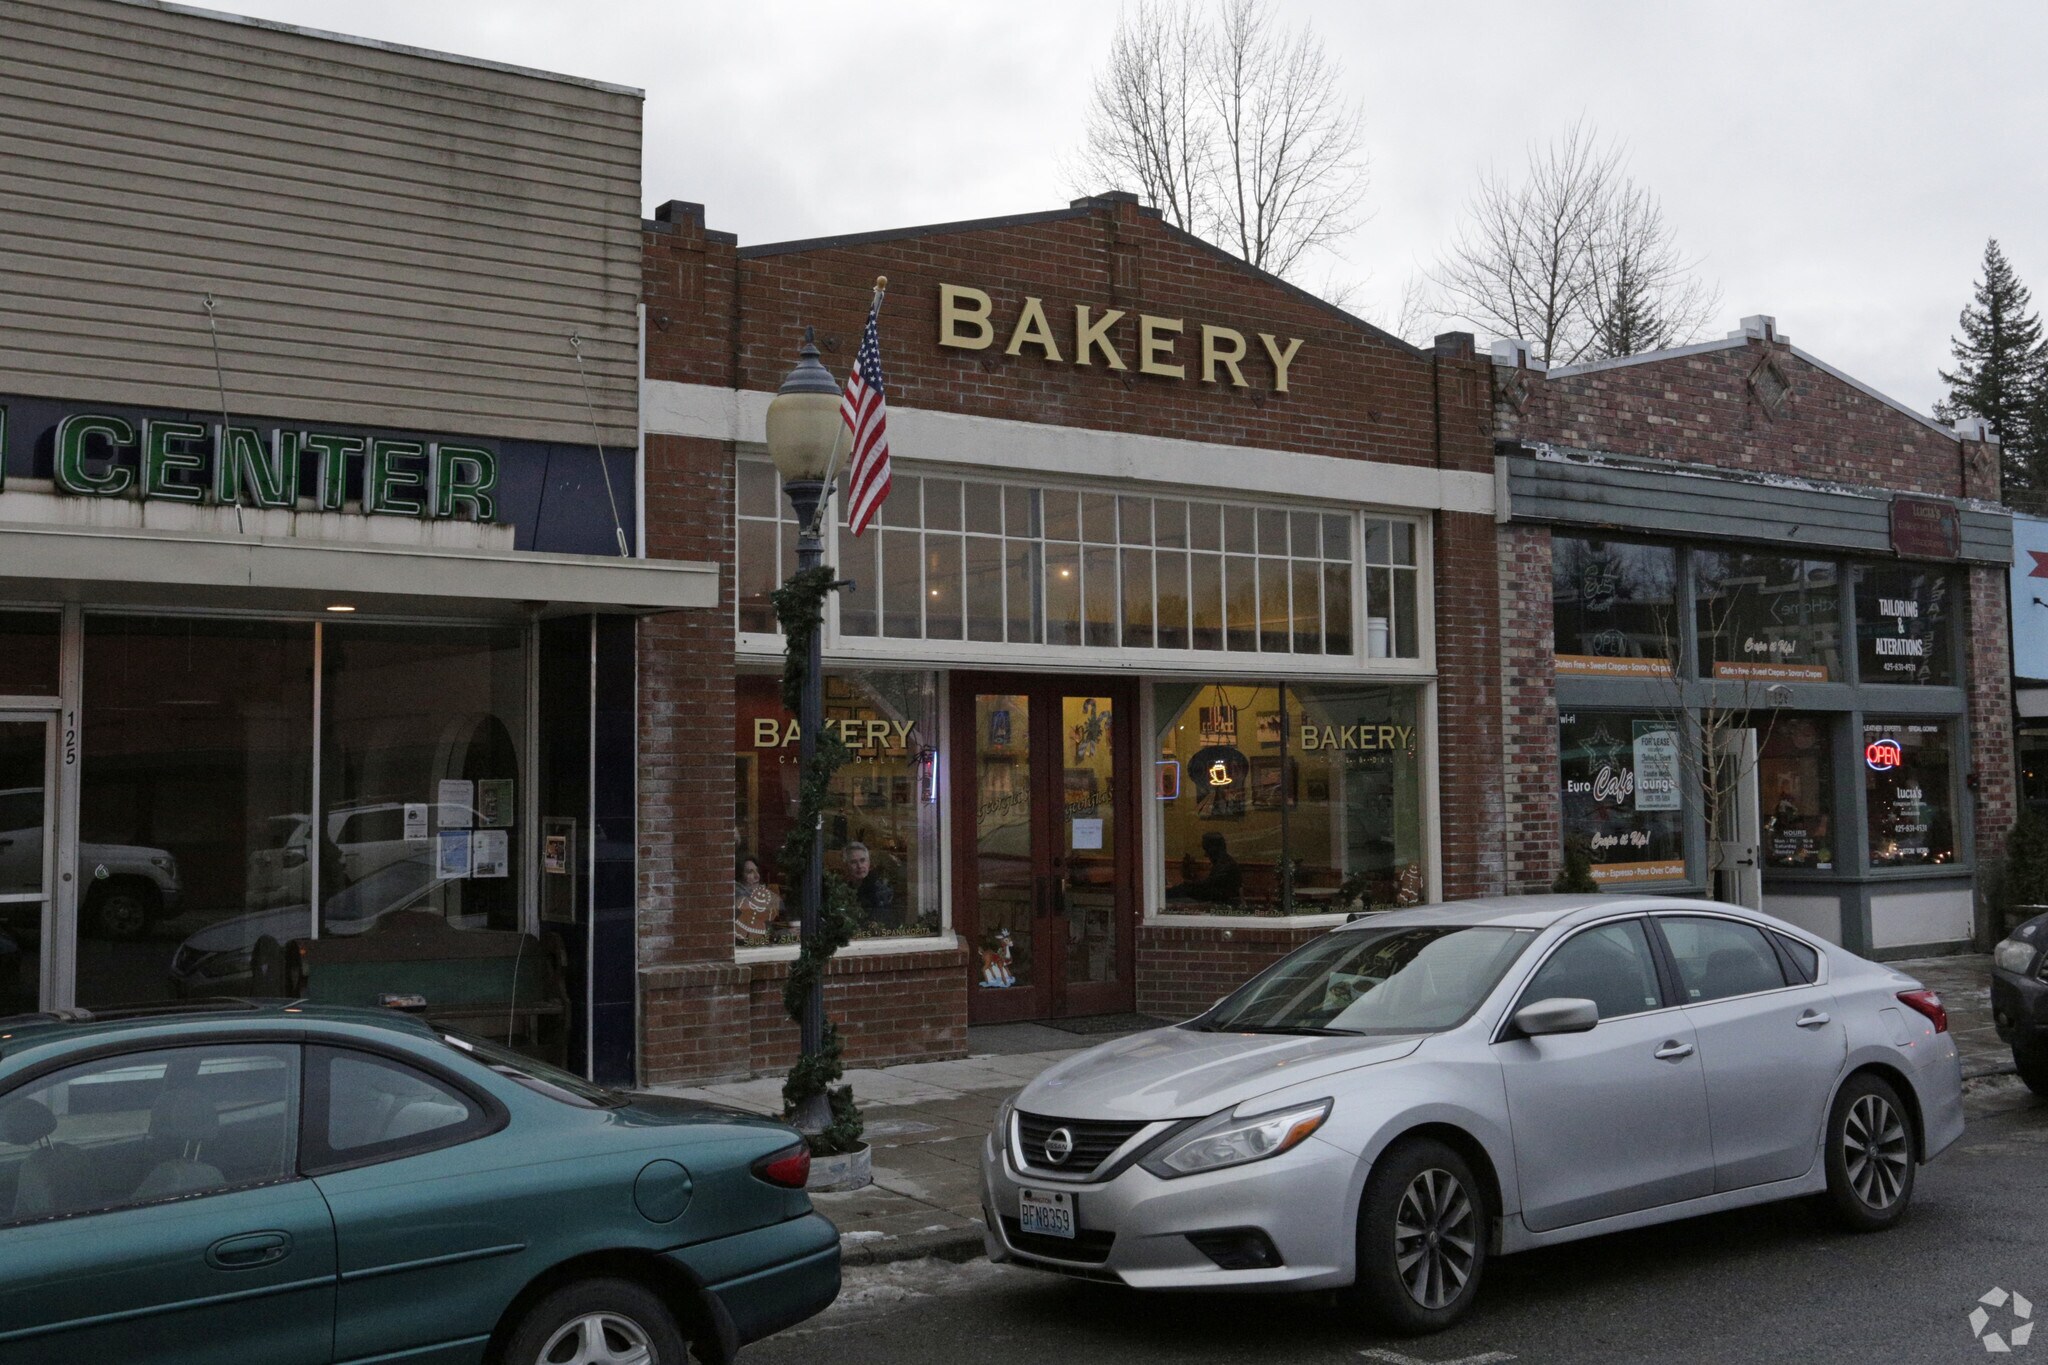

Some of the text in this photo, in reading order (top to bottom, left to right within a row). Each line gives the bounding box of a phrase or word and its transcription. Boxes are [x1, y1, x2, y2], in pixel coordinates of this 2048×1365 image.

[939, 283, 1304, 392] BAKERY
[54, 414, 498, 522] CENTER
[1879, 599, 1918, 617] TAILORING
[1898, 617, 1905, 634] &
[1876, 638, 1923, 656] ALTERATIONS
[1574, 661, 1586, 669] Free
[1590, 662, 1607, 670] Sweet
[1608, 662, 1628, 671] Crepes
[1632, 663, 1650, 672] Savory
[1738, 667, 1749, 675] Free
[1752, 668, 1767, 676] Sweet
[1768, 668, 1786, 678] Crepes
[1788, 669, 1805, 679] Savory
[1805, 670, 1822, 679] Crepes
[65, 711, 75, 765] 125
[1301, 725, 1412, 750] BAKERY
[1642, 737, 1670, 746] FOR LEASE
[856, 756, 895, 764] DELI
[1867, 745, 1900, 766] OPEN
[1567, 780, 1591, 793] Euro
[1593, 766, 1633, 804] Café
[1638, 777, 1675, 792] Lounge
[1630, 830, 1651, 849] Up!
[1590, 866, 1683, 879] offee Espresso Pour Over Coffee
[780, 933, 800, 944] SALA
[1022, 1204, 1070, 1231] BFN8359
